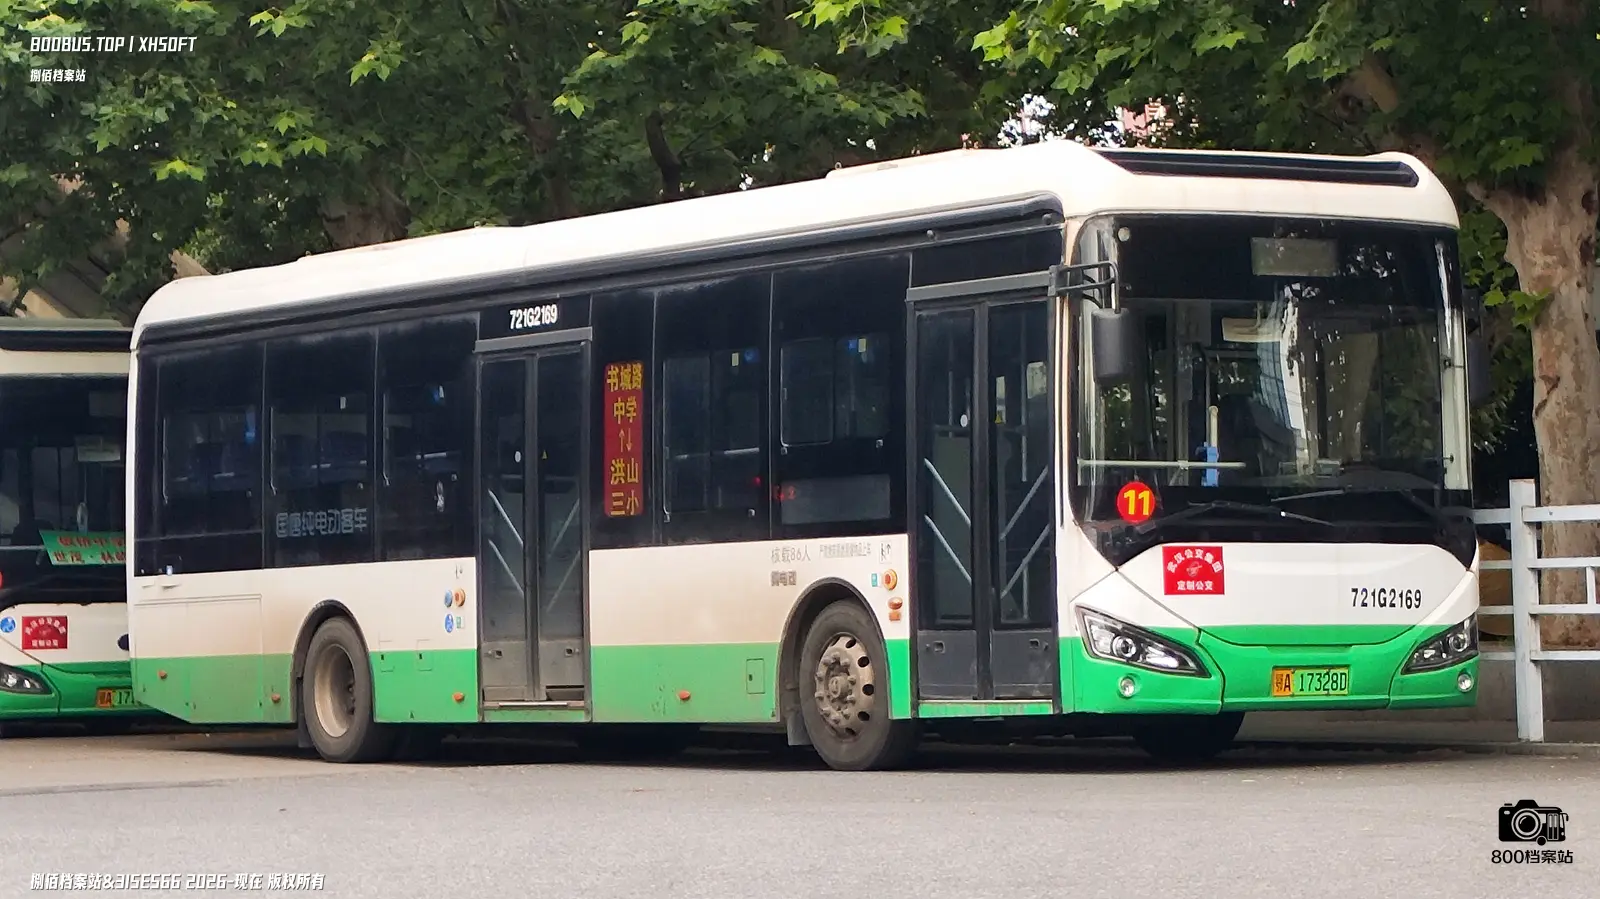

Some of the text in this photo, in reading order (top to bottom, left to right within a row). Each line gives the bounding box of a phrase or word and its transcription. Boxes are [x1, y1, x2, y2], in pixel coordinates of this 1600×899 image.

[509, 304, 558, 329] 721G2169
[606, 362, 643, 392] 书城路
[613, 396, 637, 424] 中学
[610, 457, 639, 485] 洪山
[610, 490, 640, 516] 三小
[1123, 489, 1150, 516] 11
[1351, 588, 1422, 609] 721G2169
